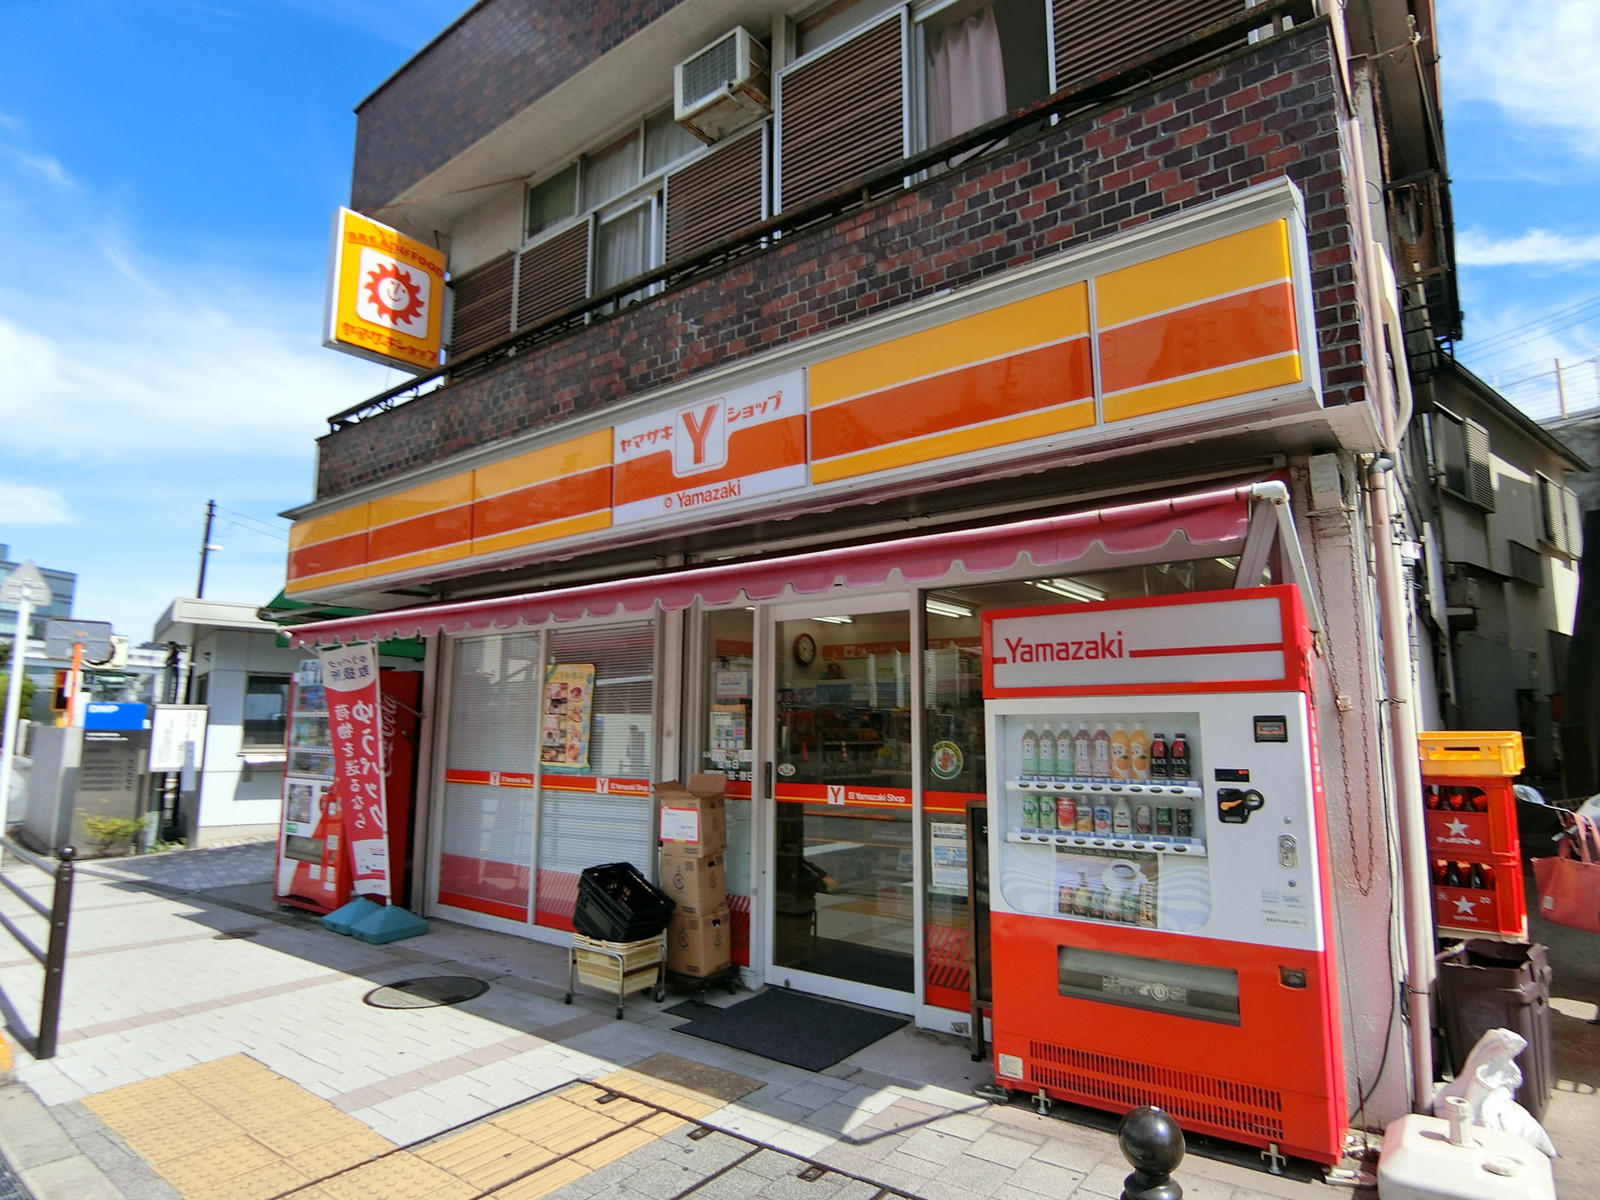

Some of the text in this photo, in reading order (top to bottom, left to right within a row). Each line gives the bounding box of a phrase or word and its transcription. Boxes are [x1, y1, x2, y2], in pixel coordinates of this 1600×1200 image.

[619, 390, 783, 465] ヤマザキ Y ショップ
[676, 480, 742, 508] Yamazaki
[1005, 631, 1124, 663] Yamazaki
[855, 792, 906, 804] Yamazaki Shop
